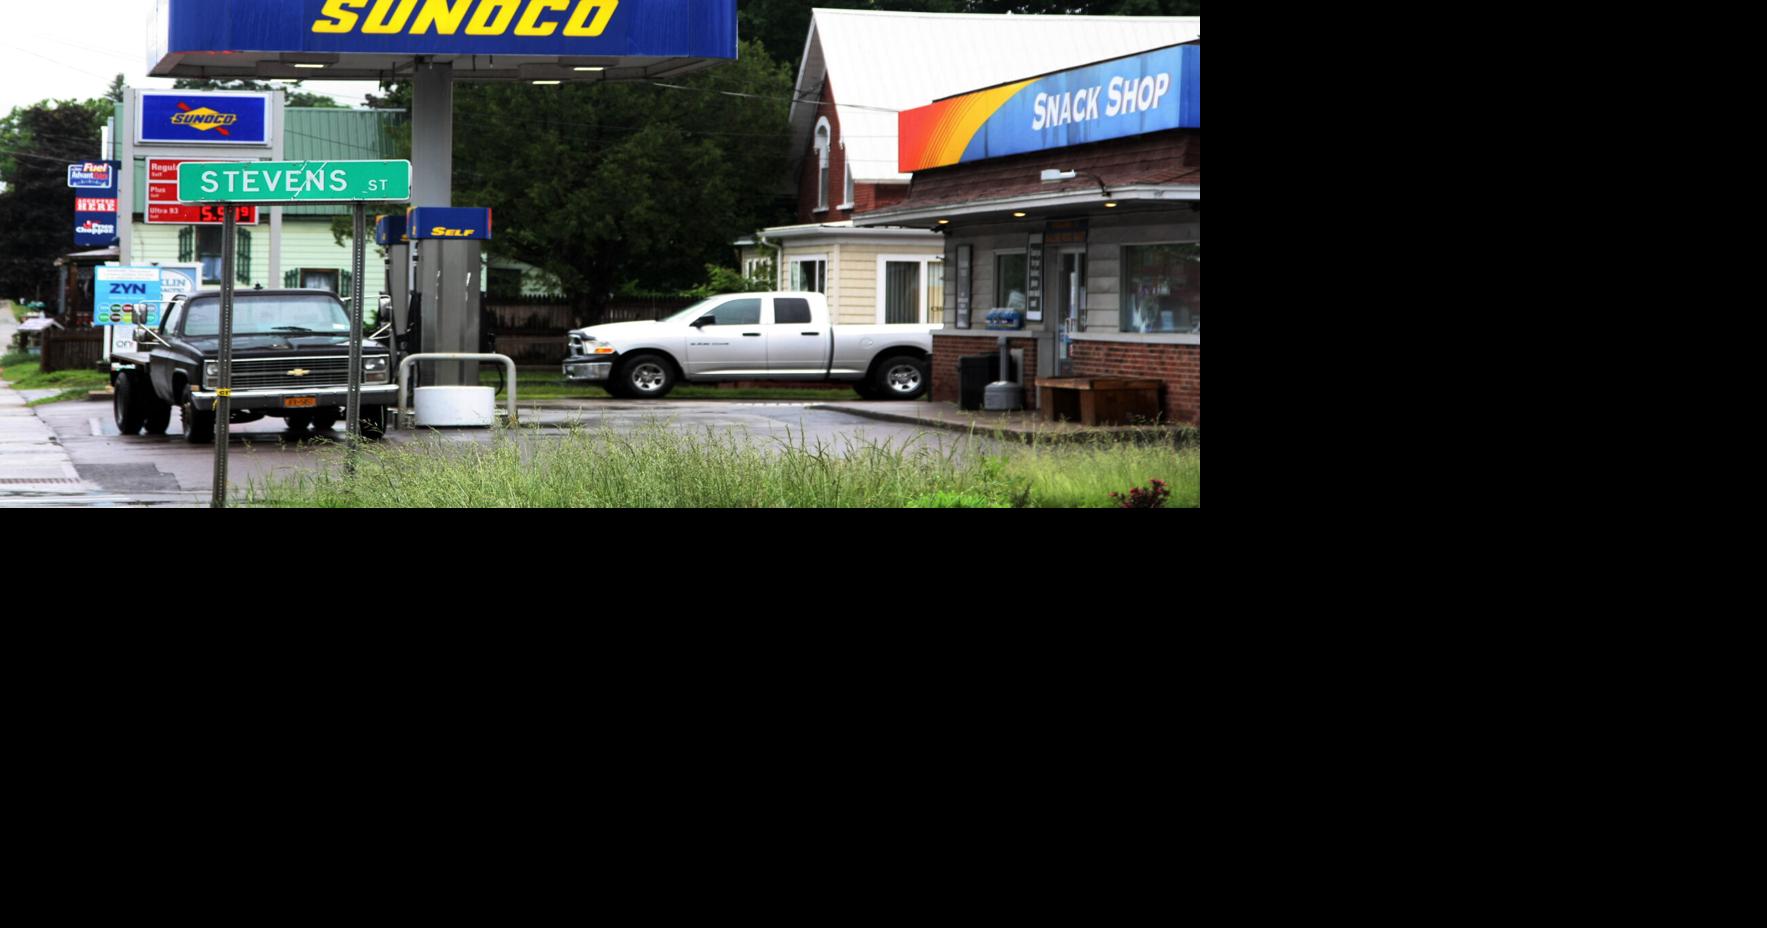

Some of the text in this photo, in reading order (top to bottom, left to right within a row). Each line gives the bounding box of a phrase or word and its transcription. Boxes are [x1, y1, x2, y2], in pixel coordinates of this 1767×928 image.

[311, 0, 619, 37] SUNOCO
[1032, 72, 1170, 131] SNACK SHOP
[171, 113, 236, 125] SUNOCO
[83, 162, 108, 173] Fuel
[201, 169, 388, 193] STEVENS ST
[78, 203, 115, 212] HERE
[110, 283, 146, 295] ZYN
